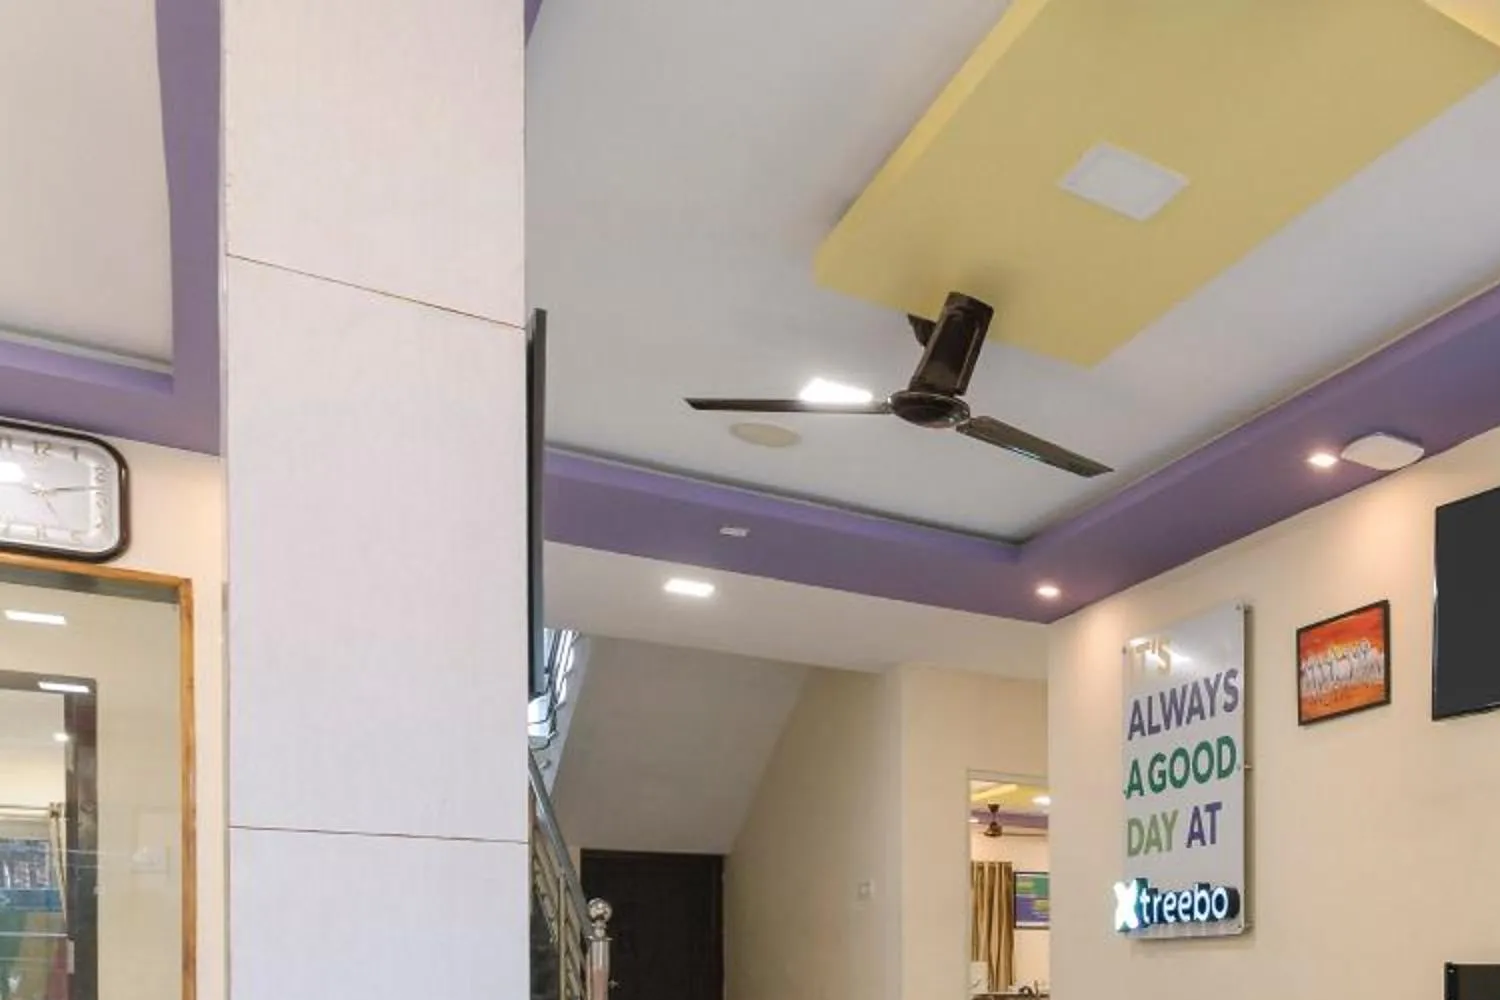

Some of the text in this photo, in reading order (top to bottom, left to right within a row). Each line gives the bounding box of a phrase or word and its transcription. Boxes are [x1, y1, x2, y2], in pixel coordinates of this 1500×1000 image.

[1127, 667, 1240, 742] ALWAYS
[1126, 735, 1238, 800] A GOOD
[1127, 801, 1223, 858] DAY AT
[1139, 883, 1230, 925] treebo
